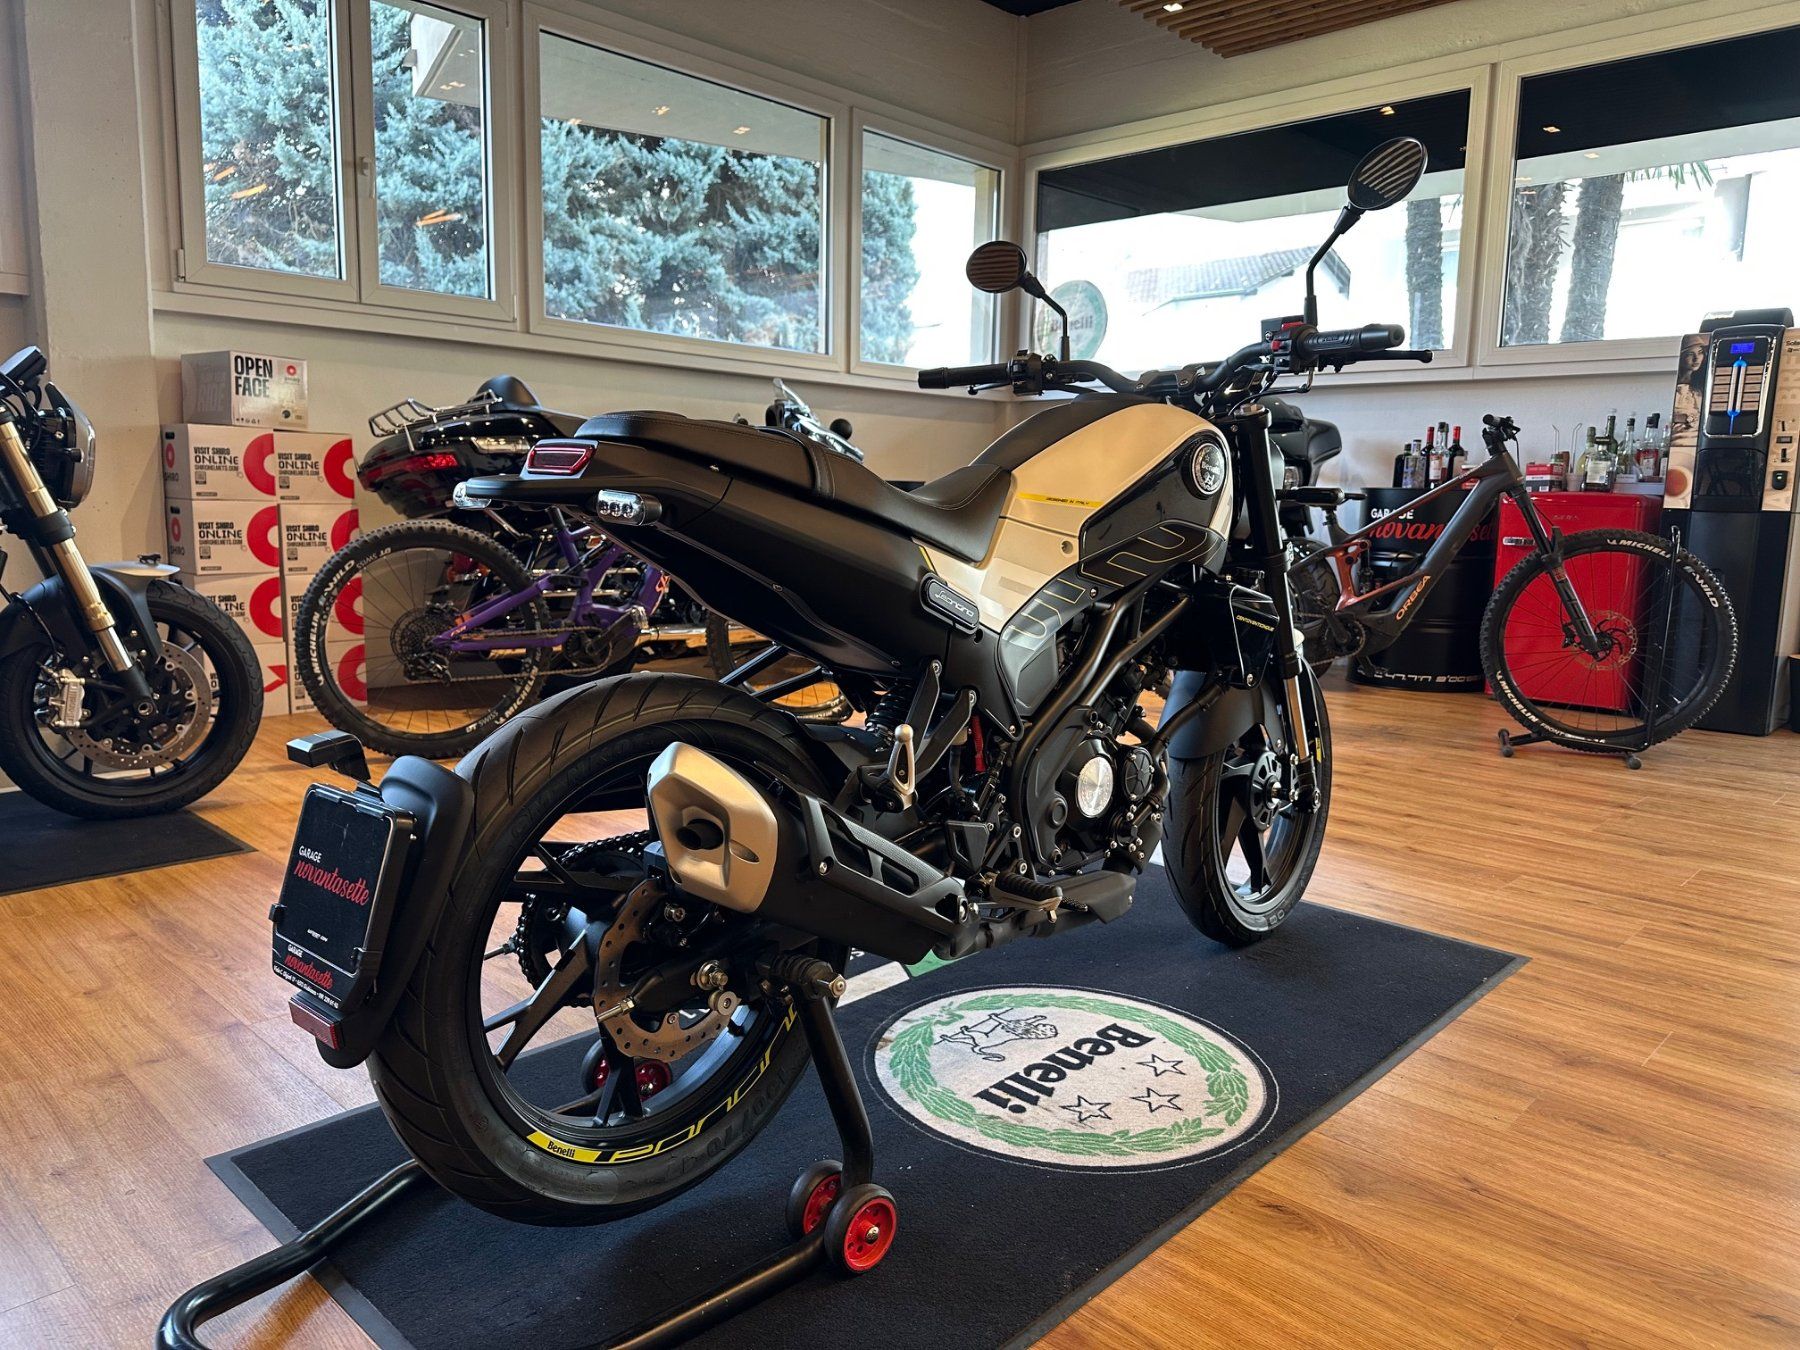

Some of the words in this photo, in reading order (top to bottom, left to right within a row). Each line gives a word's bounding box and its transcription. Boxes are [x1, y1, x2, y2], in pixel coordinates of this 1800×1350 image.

[234, 355, 273, 378] OPEN
[235, 375, 270, 398] FACE
[194, 446, 210, 455] VISIT
[211, 447, 230, 456] SHIRO
[194, 454, 239, 465] ONLINE
[277, 452, 293, 460] VISIT
[278, 460, 320, 470] ONLINE
[198, 521, 214, 530] VISIT
[215, 522, 234, 530] SHIRO
[198, 529, 242, 539] ONLINE
[286, 532, 327, 542] ONLINE
[356, 553, 378, 570] SWISS
[1395, 575, 1431, 620] ORBEA
[309, 611, 320, 675] MICHELIN
[1499, 680, 1539, 723] MICHELIN
[298, 845, 322, 863] GARAGE
[293, 860, 370, 906] novantasette
[973, 1023, 1156, 1114] Benelli
[547, 1140, 576, 1158] Benelli
